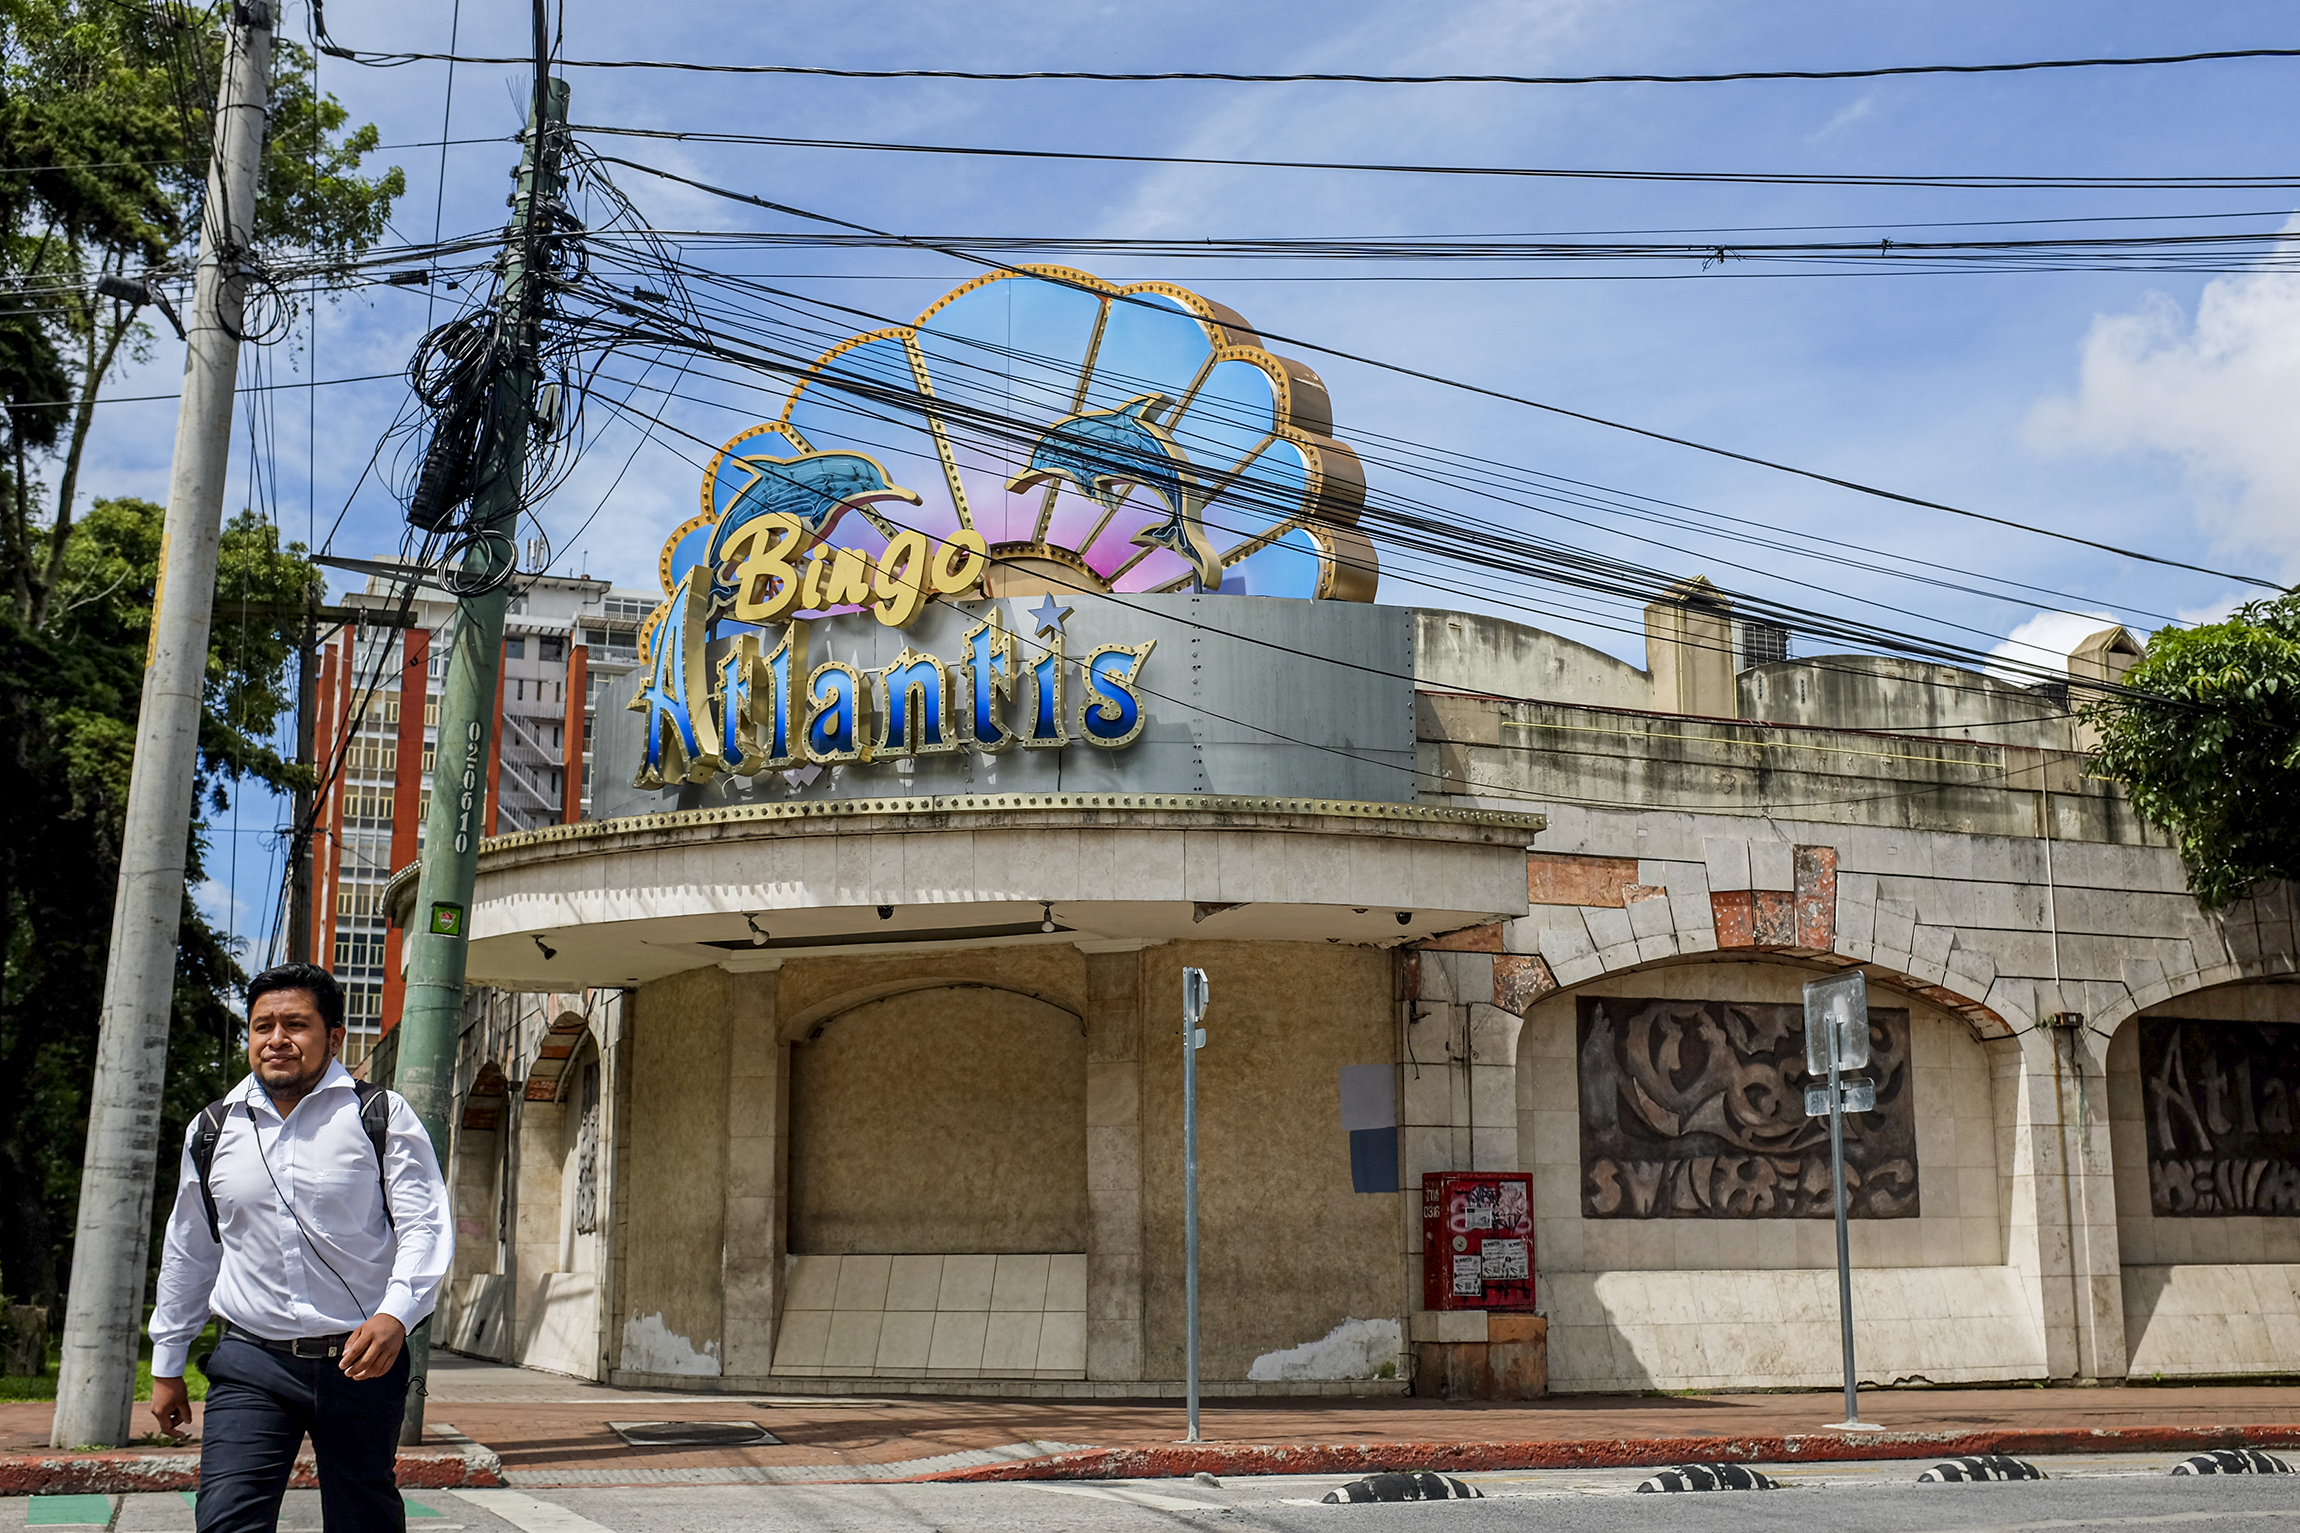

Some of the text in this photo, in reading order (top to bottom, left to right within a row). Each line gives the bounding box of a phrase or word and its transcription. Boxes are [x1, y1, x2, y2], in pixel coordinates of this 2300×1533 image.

[719, 512, 991, 629] Bingo
[626, 564, 1158, 790] Atlantis
[2149, 1022, 2300, 1152] Atla
